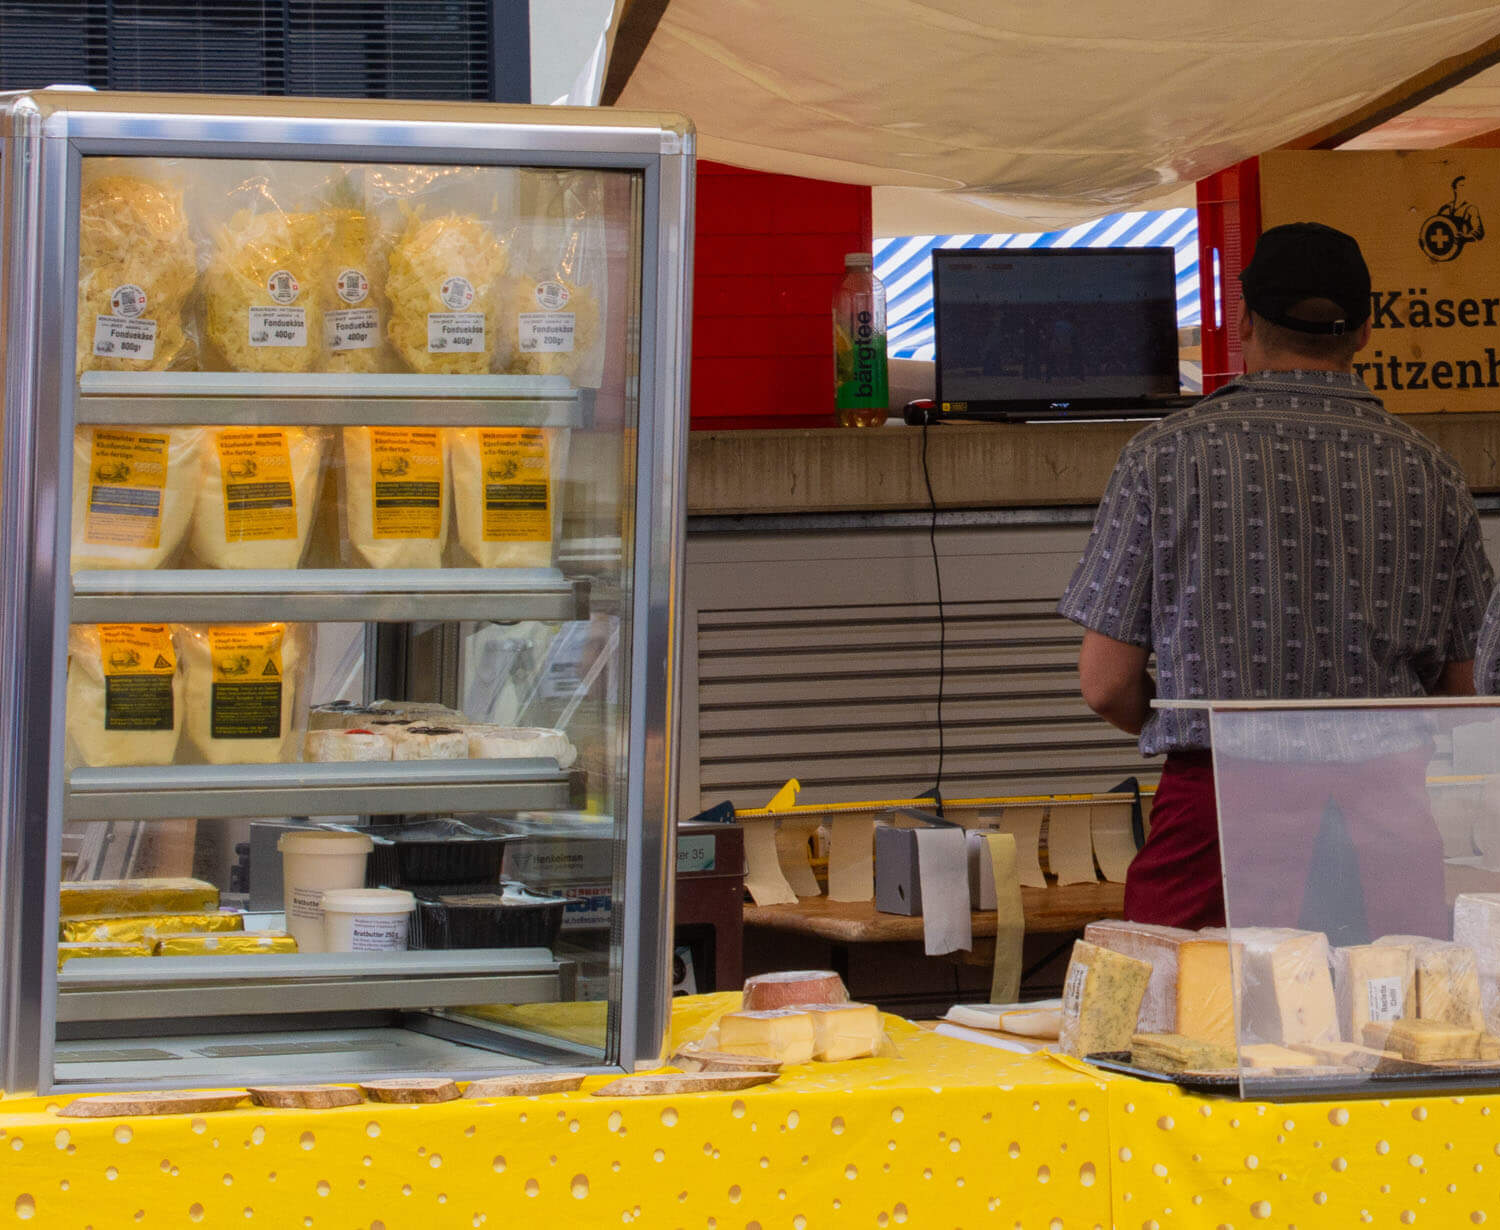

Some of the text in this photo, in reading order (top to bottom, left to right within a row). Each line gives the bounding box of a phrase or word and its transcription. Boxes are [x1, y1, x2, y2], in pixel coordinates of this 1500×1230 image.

[263, 319, 304, 328] Fonduekäse
[110, 328, 154, 341] Fonduekäse
[442, 325, 483, 334] Fonduekäse
[532, 325, 574, 334] Fonduekäse
[274, 330, 296, 340] 400gr
[347, 332, 368, 342] 400gr
[452, 336, 474, 346] 400gr
[543, 336, 565, 346] 200gr
[854, 310, 876, 398] bärgtee
[691, 849, 705, 860] 35
[352, 929, 384, 938] Bratbutter
